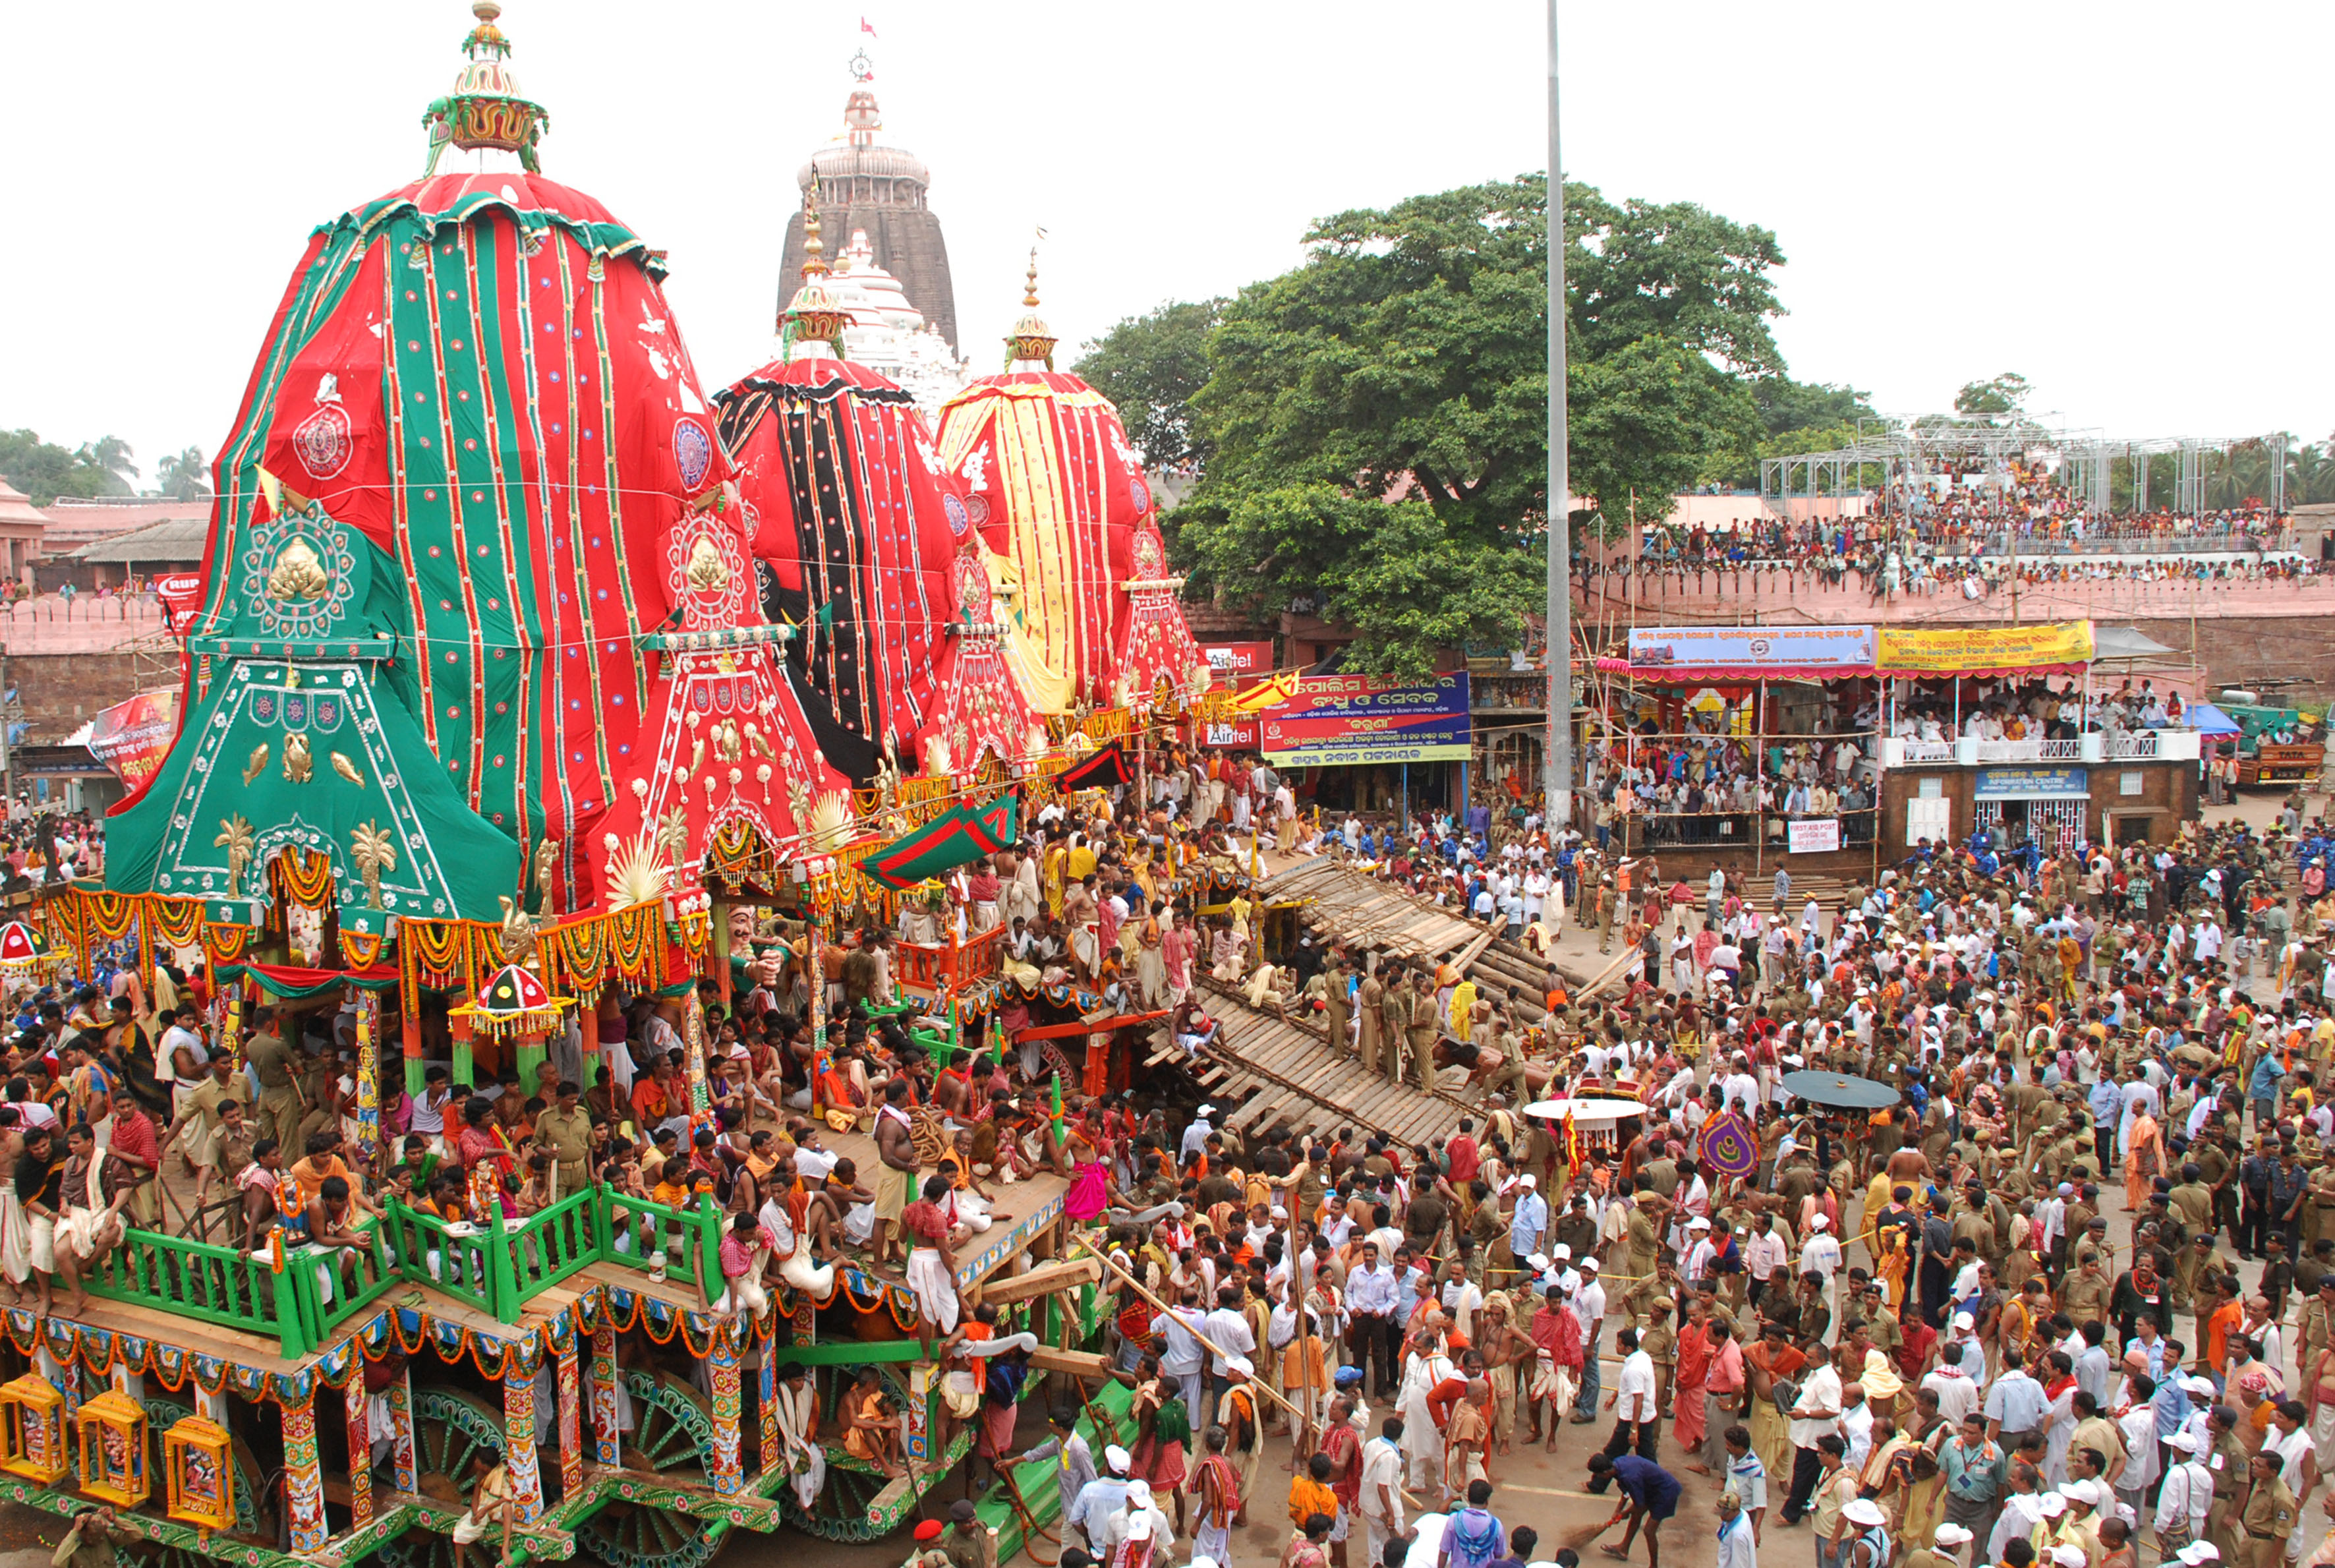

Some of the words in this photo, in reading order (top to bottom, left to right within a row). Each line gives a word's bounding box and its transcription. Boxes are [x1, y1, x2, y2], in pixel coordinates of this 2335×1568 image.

[1211, 653, 1251, 667] Aitel
[1355, 694, 1371, 706] ଓ
[1377, 692, 1439, 705] ସେବକ
[1210, 728, 1252, 742] Airtel
